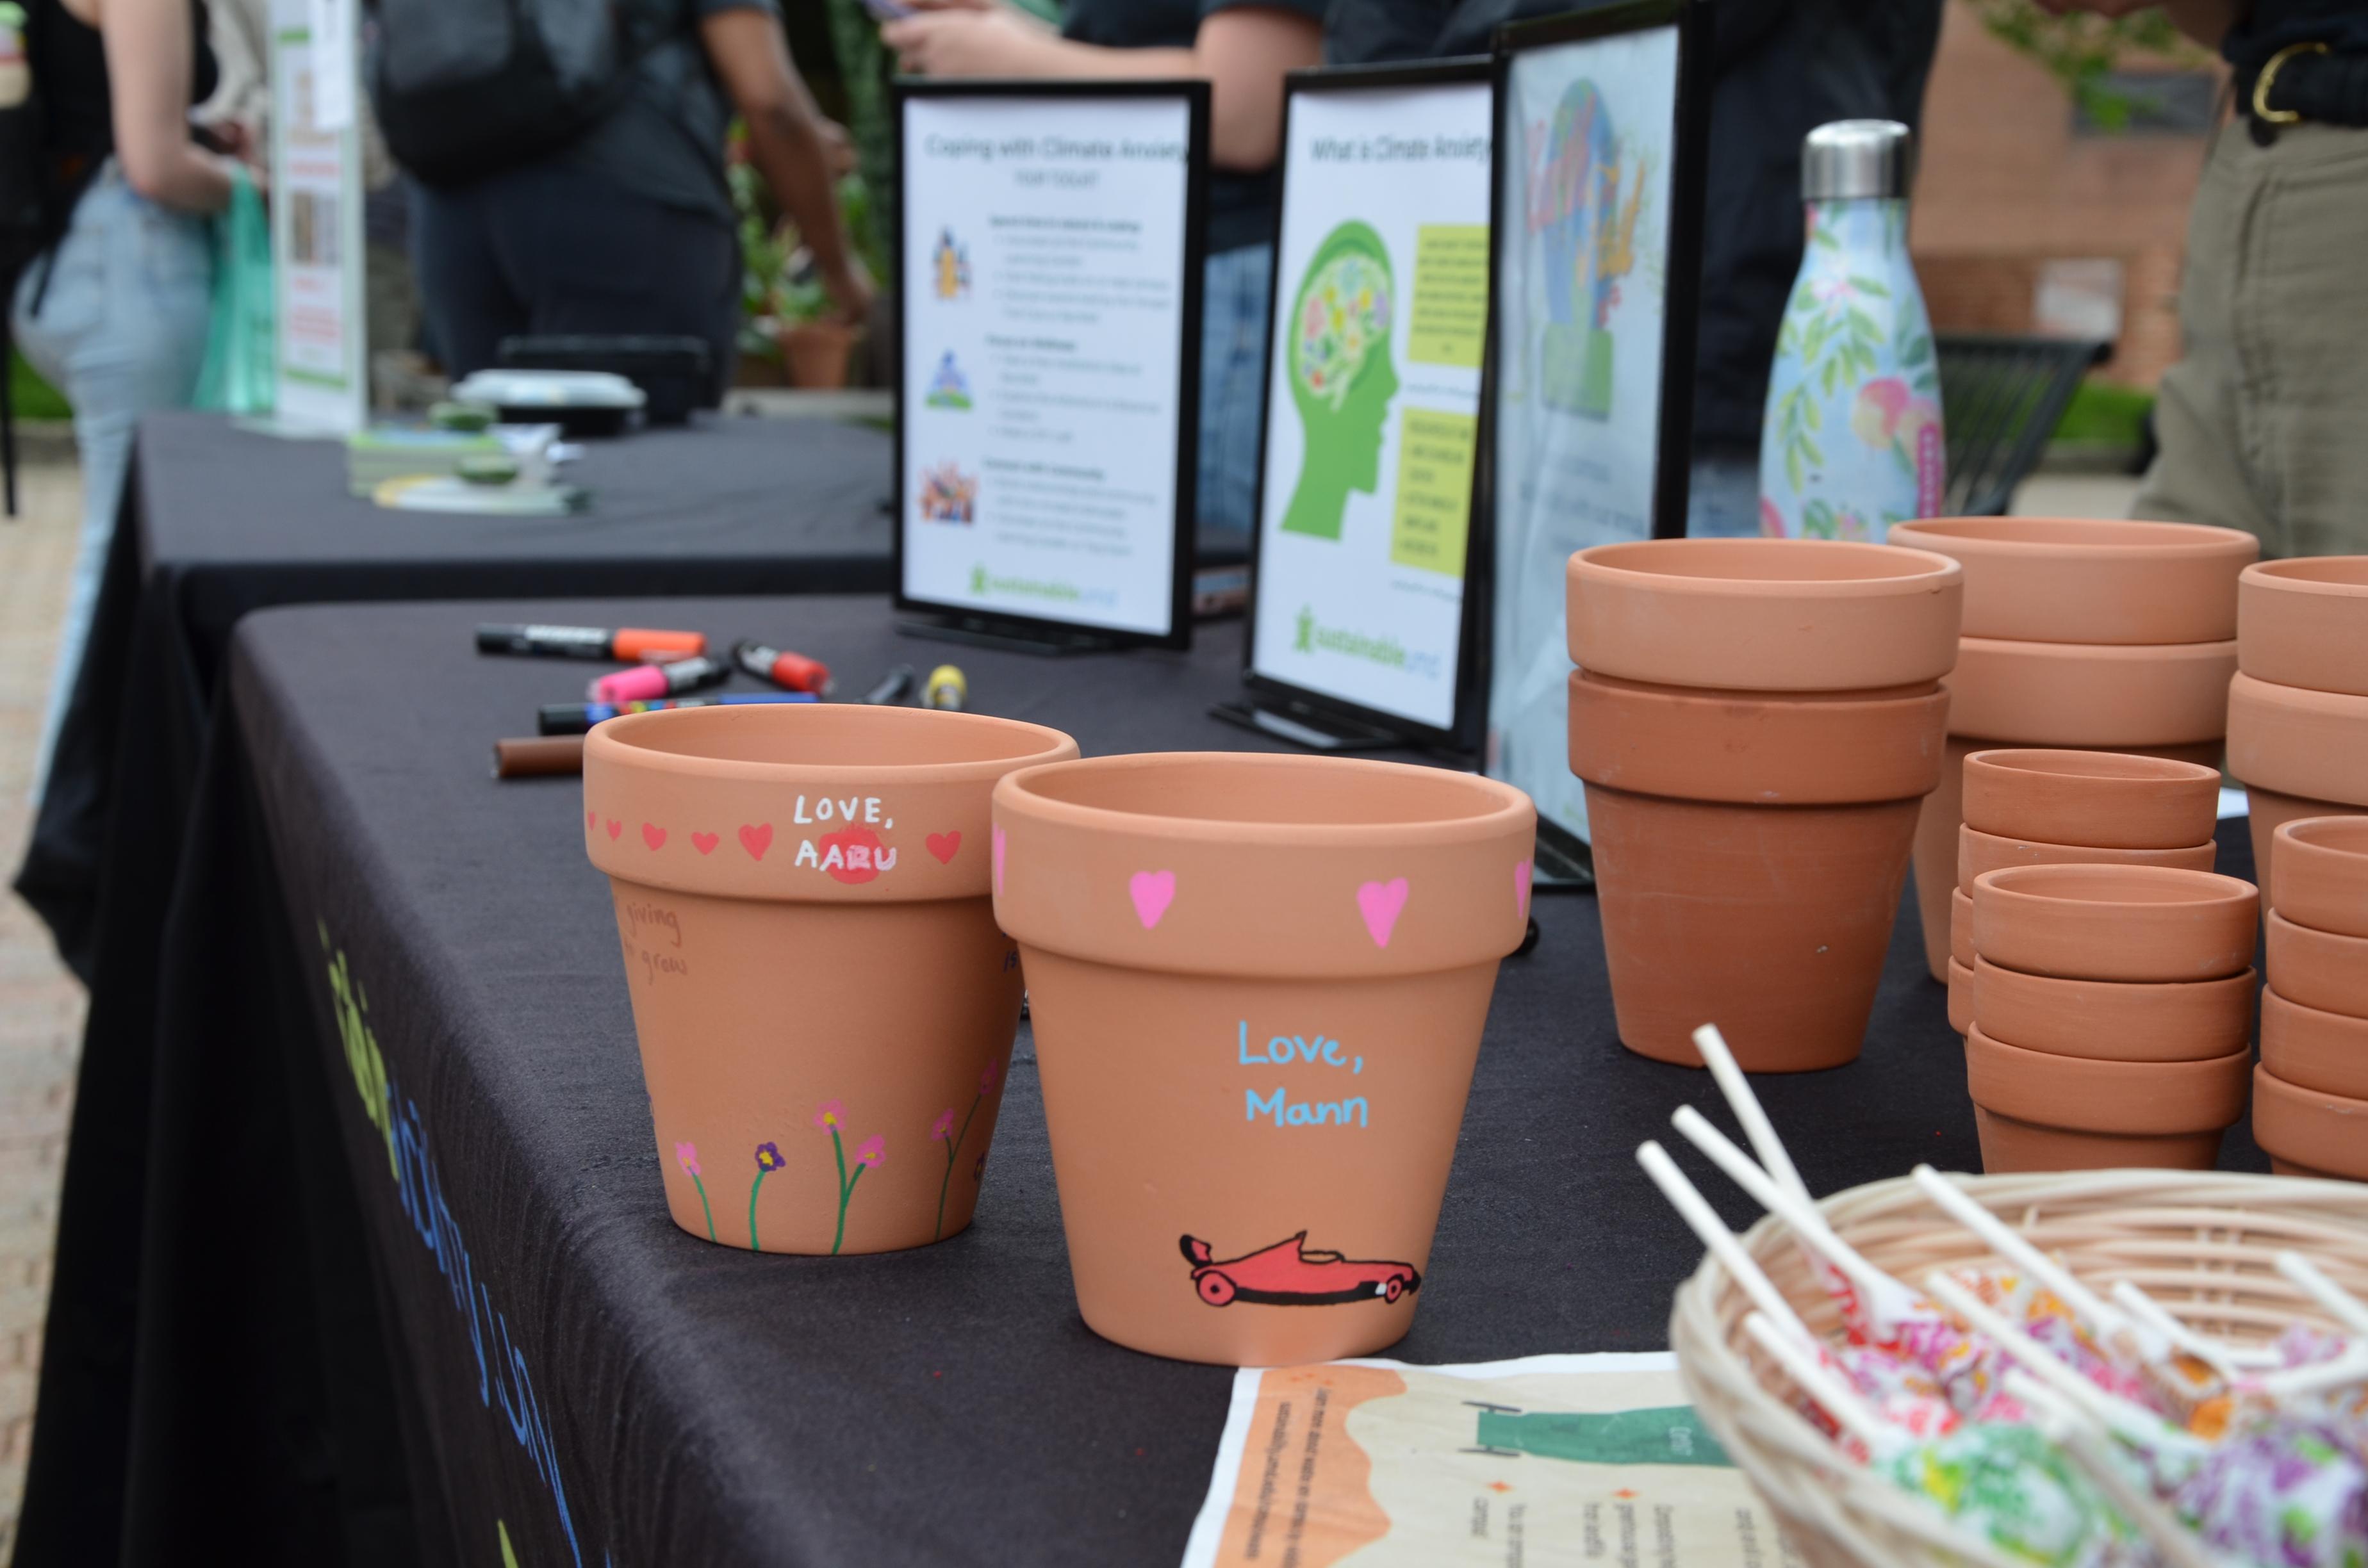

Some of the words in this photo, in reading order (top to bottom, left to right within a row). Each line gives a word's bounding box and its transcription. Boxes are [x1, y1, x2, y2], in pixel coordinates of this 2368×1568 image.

[925, 135, 994, 161] Coping
[997, 137, 1037, 158] with
[1041, 136, 1114, 159] Climate
[1310, 136, 1355, 161] What
[1374, 134, 1430, 161] Climate
[794, 795, 894, 829] LOVE,
[794, 839, 897, 872] AARU
[1239, 1020, 1363, 1074] Love,
[1246, 1087, 1368, 1127] Mann
